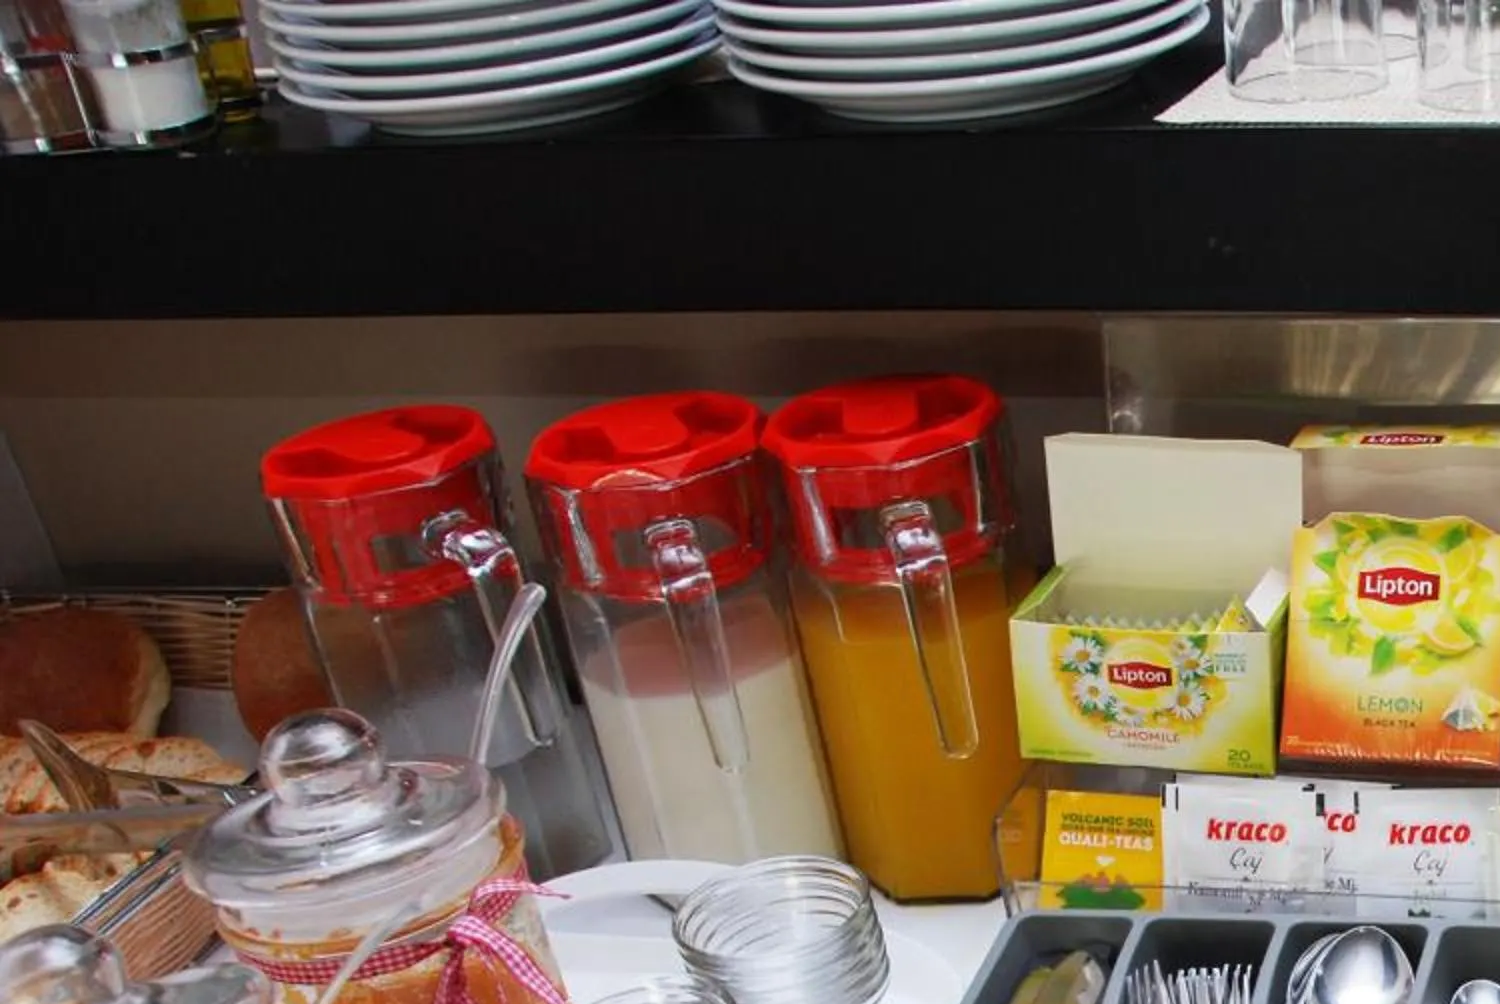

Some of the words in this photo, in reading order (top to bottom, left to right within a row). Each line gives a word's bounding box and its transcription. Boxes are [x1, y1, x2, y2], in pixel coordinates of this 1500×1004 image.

[1367, 435, 1436, 444] Lipton
[1364, 575, 1434, 599] Lipton
[1112, 664, 1168, 684] Lipton
[1357, 695, 1423, 713] LEMON
[1363, 718, 1395, 727] BLACK
[1398, 719, 1416, 728] TEA
[1107, 728, 1180, 744] CAMOMILE
[1228, 749, 1250, 762] 20
[1061, 813, 1123, 826] VOLCANIC
[1207, 818, 1287, 843] kraco
[1389, 823, 1471, 845] kraco
[1060, 831, 1153, 851] QUALI-TEAS
